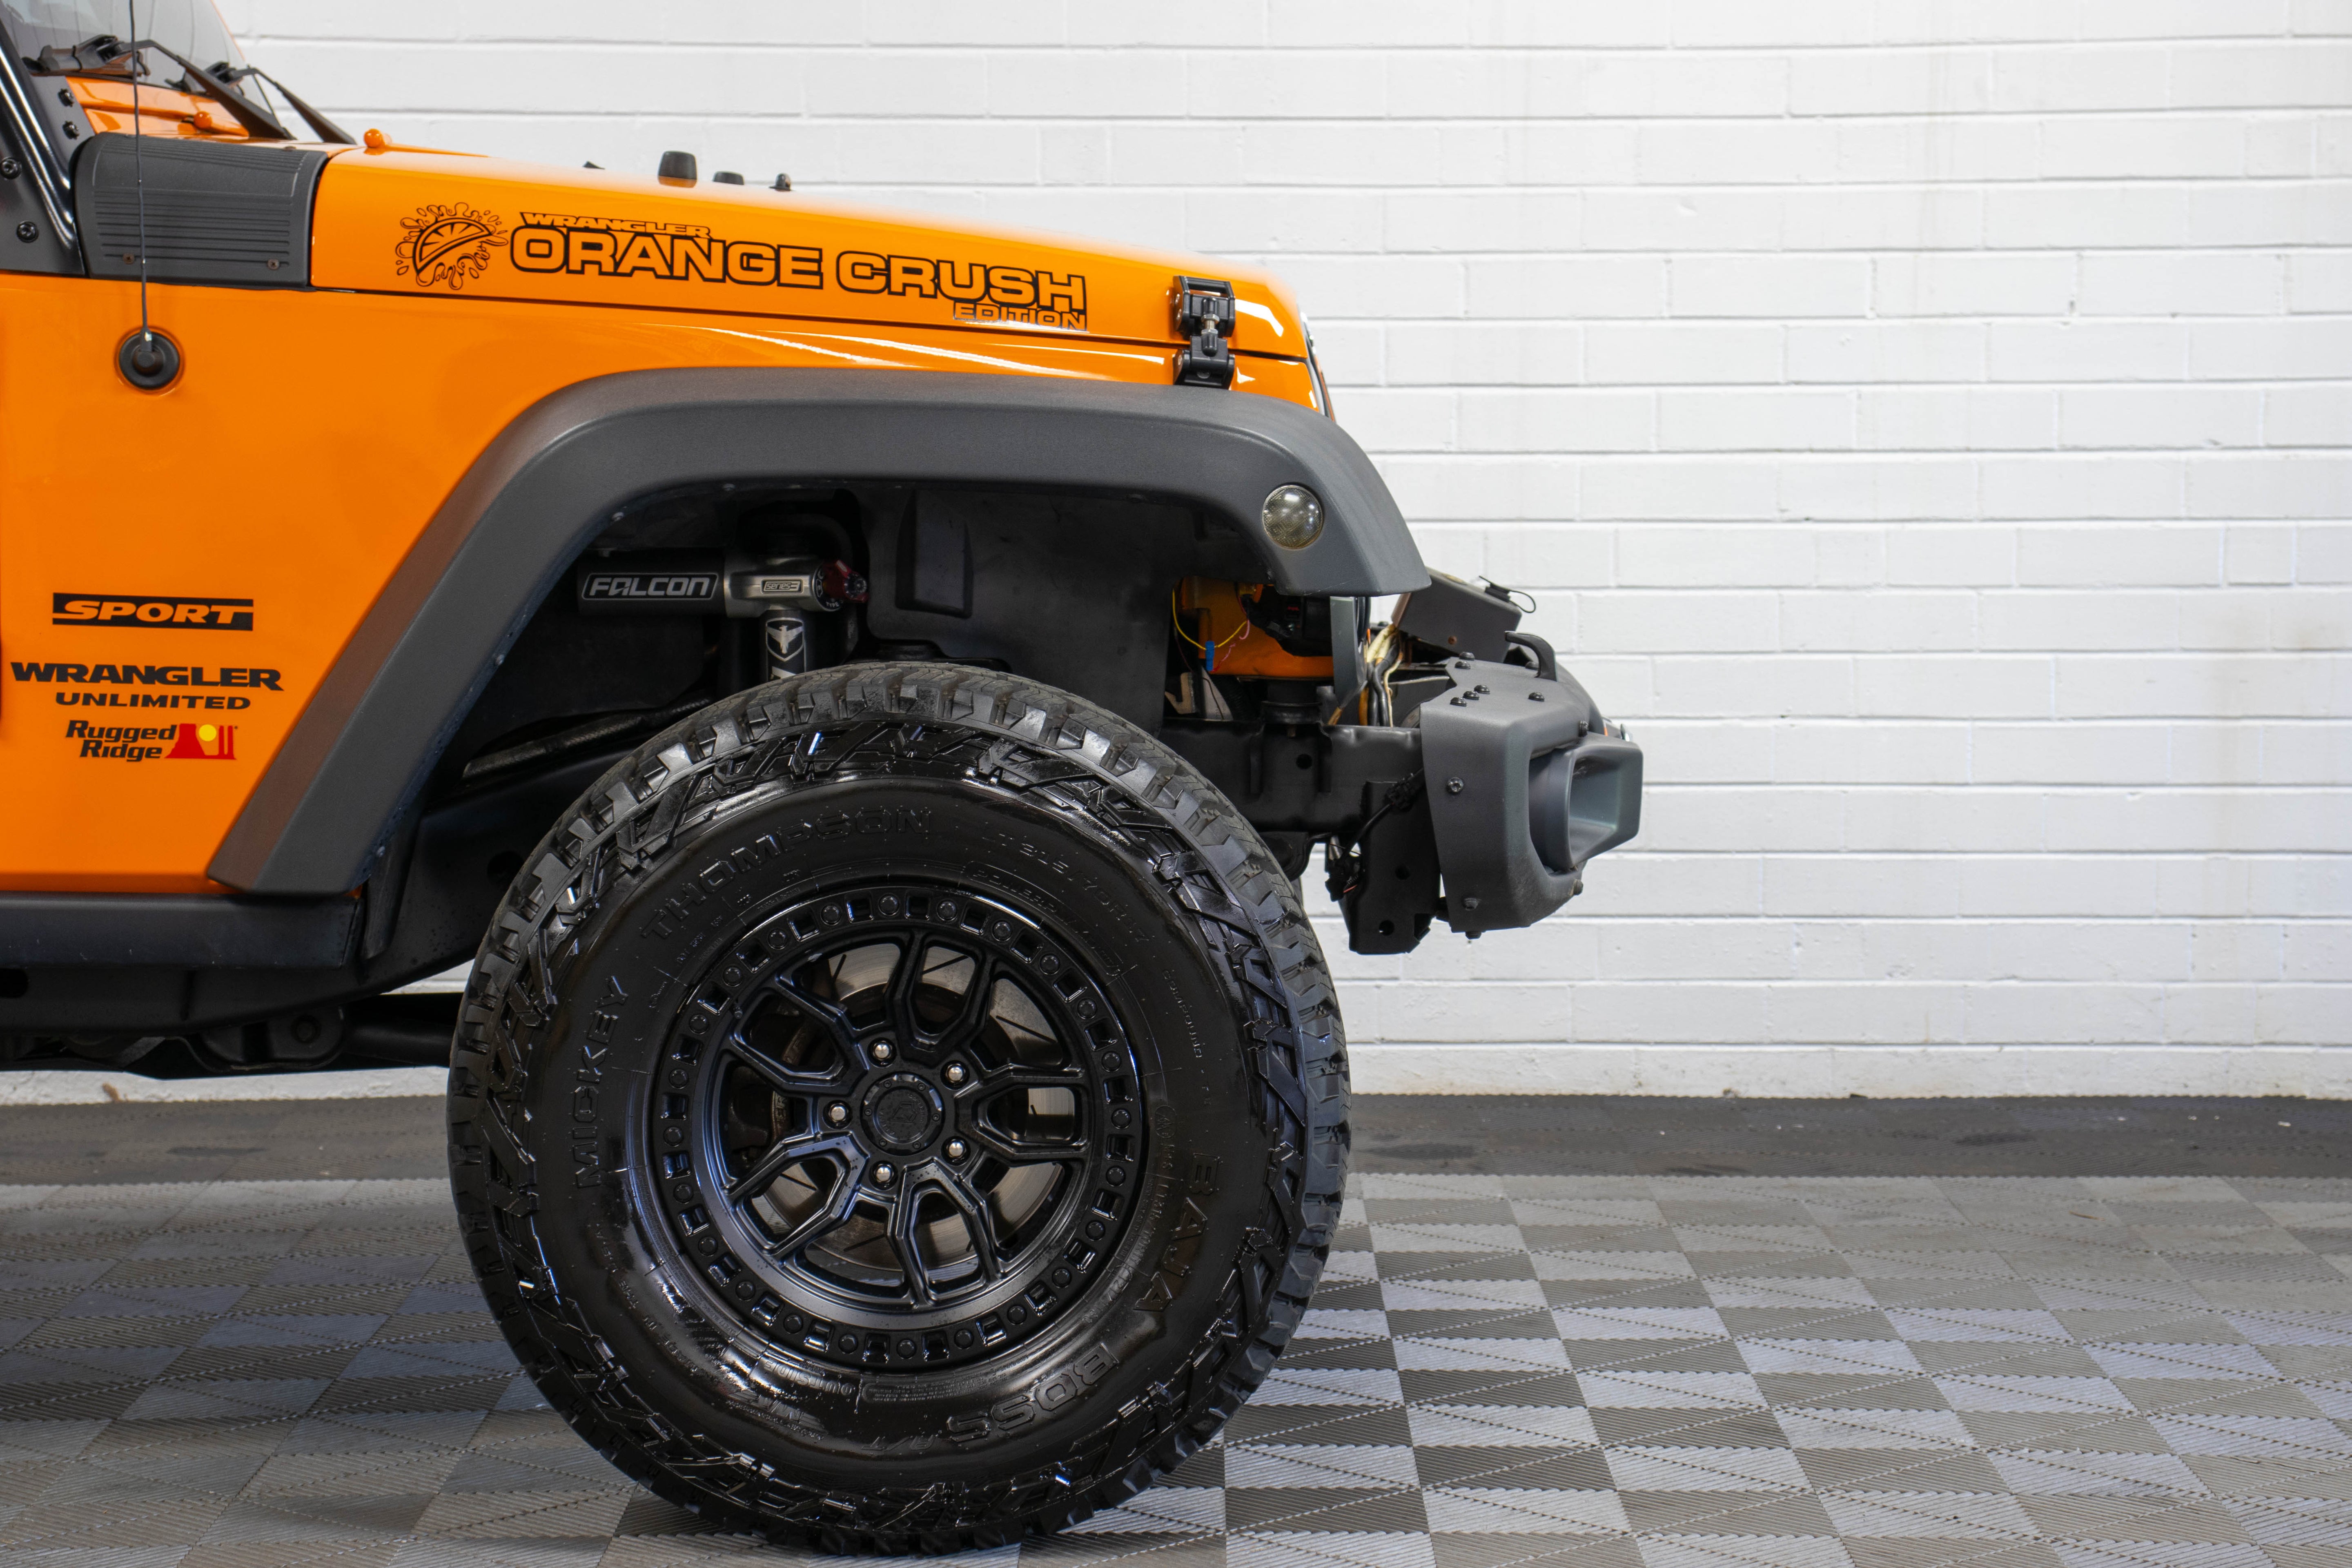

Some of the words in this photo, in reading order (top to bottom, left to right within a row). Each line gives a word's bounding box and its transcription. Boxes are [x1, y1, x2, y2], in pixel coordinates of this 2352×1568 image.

[519, 212, 714, 240] WRANGLER
[510, 225, 823, 290] ORANGE
[836, 250, 1087, 313] CRUSH
[953, 300, 1087, 331] EDITION
[589, 577, 711, 596] FALCON
[53, 600, 254, 624] SPORT
[11, 662, 284, 691] WRANGLER
[56, 693, 251, 710] UNLIMITED
[66, 720, 177, 743] Rugged
[80, 739, 163, 762] Ridge
[570, 975, 628, 1189] MICKEY
[641, 805, 931, 940] THOMPSON
[1134, 1152, 1220, 1312] BAJA
[764, 1357, 853, 1396] OUTSIDE
[946, 1343, 1119, 1443] BOSS
